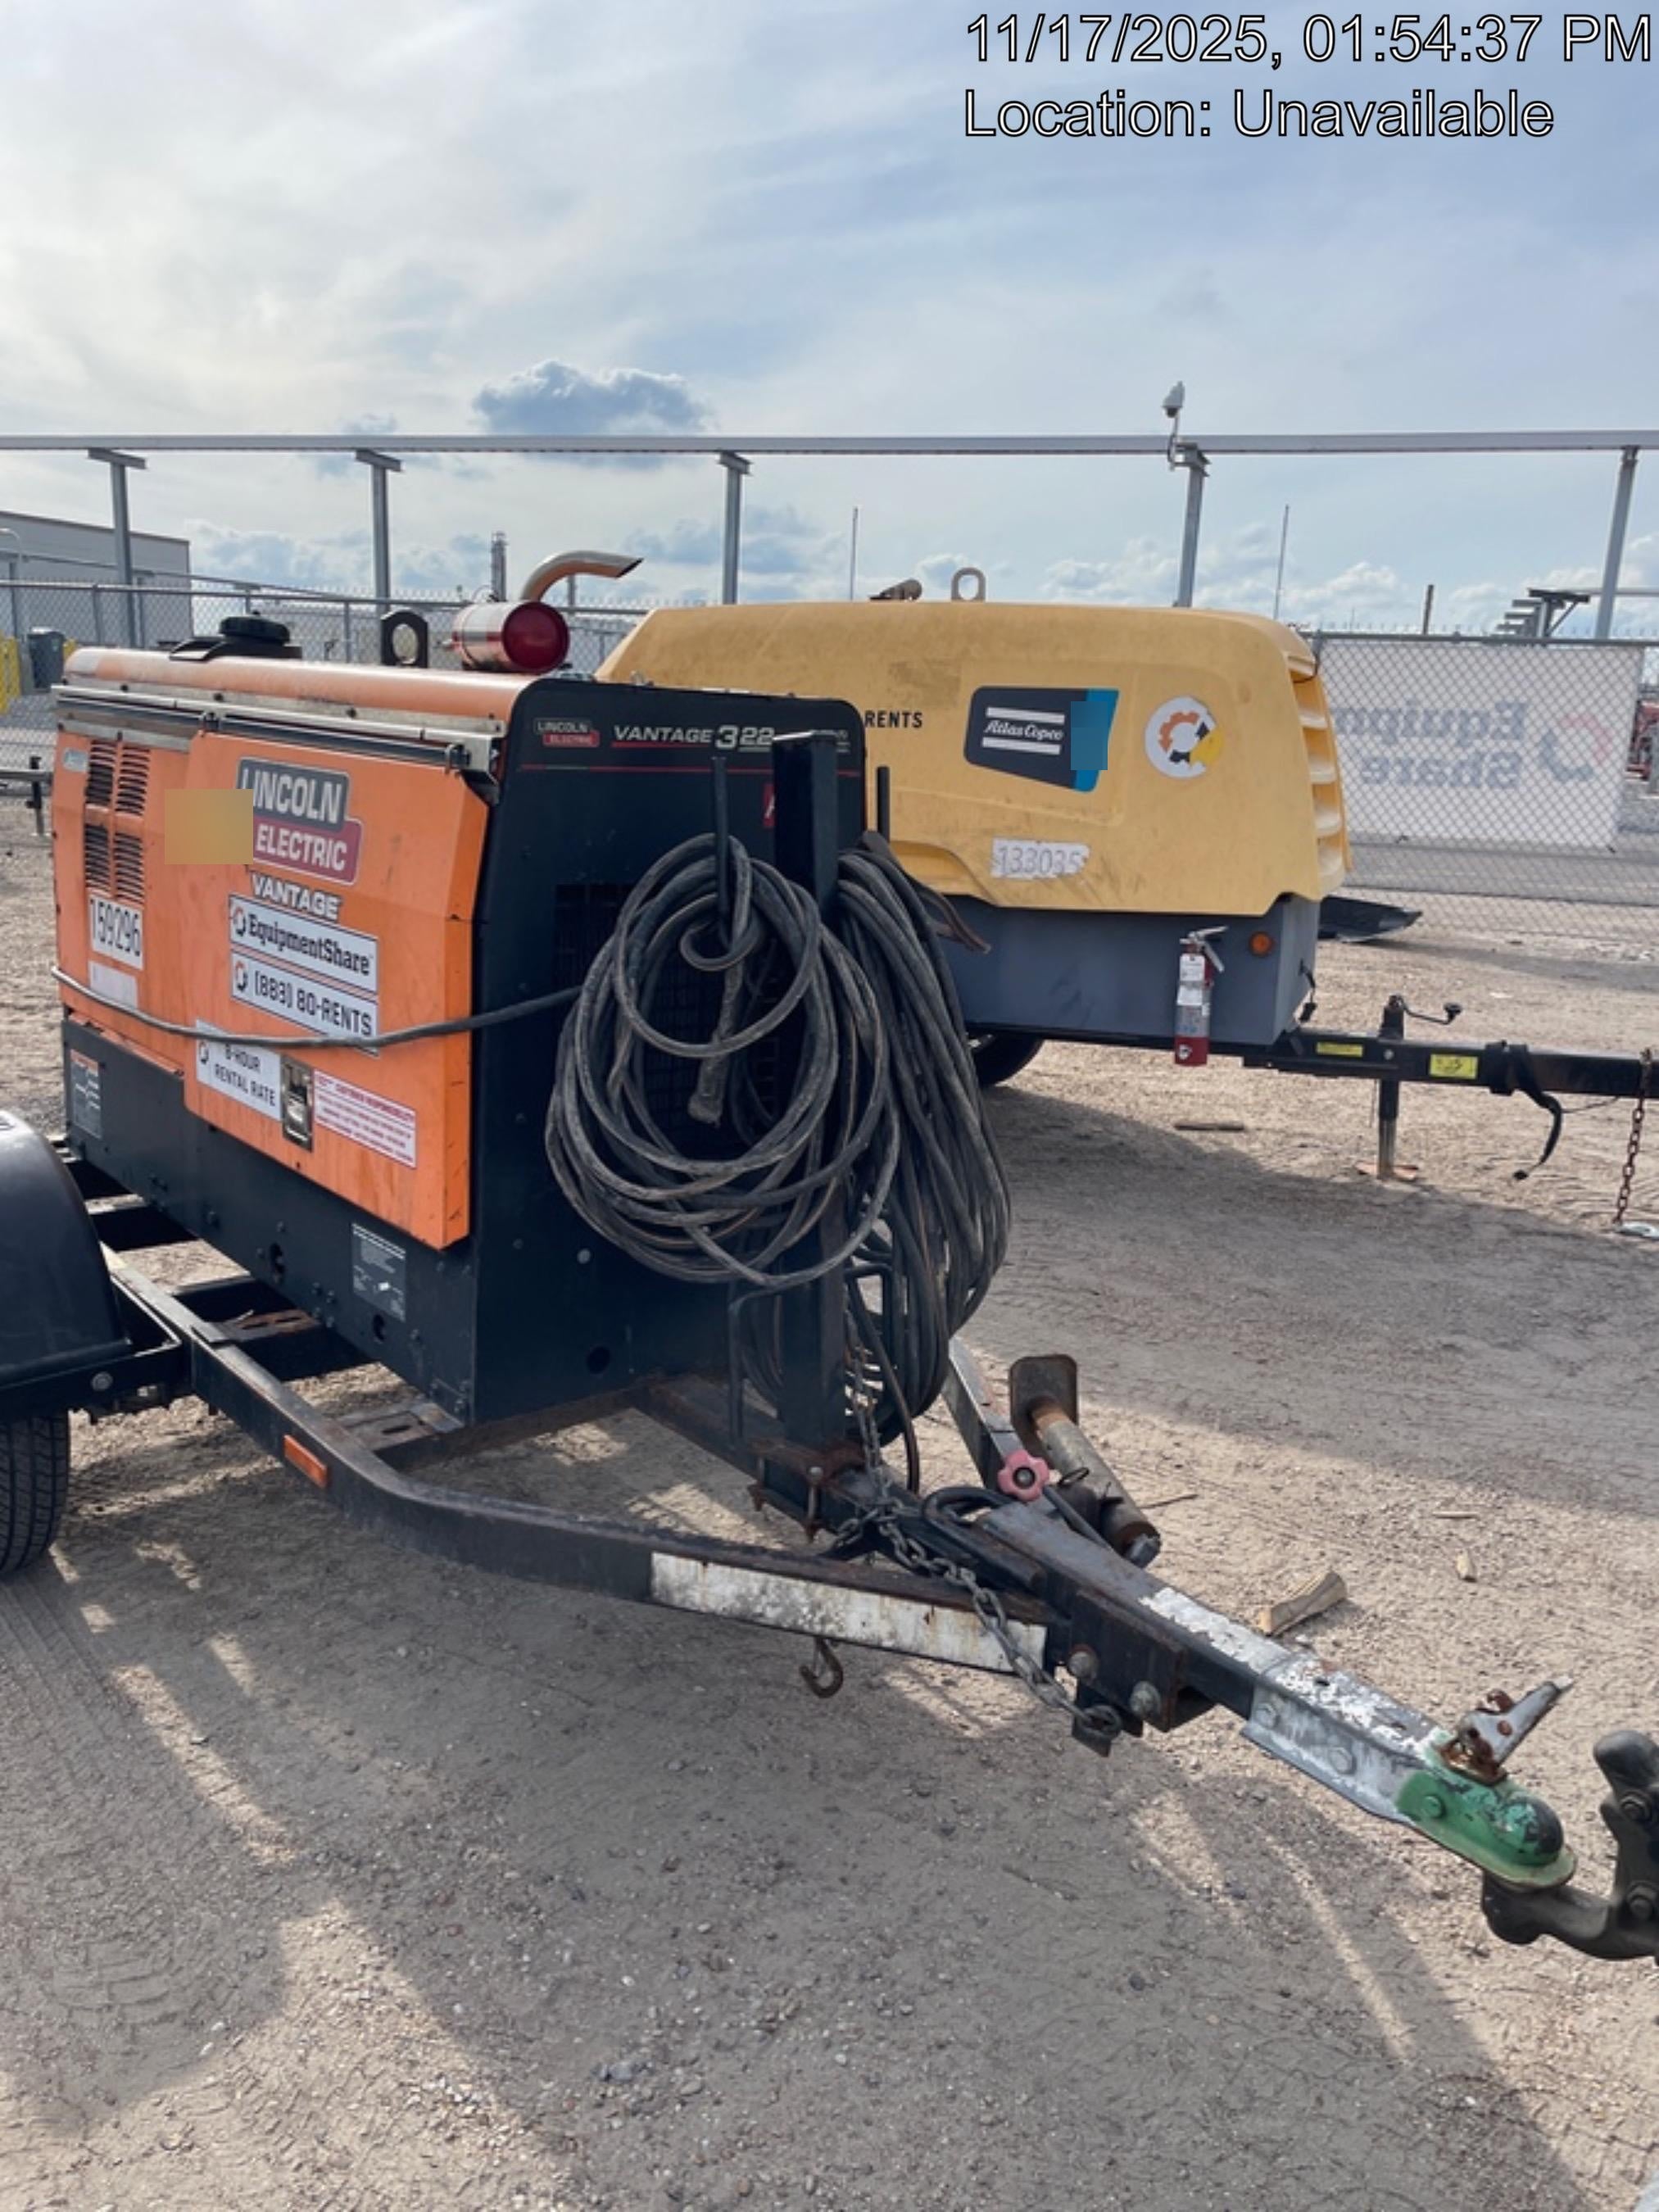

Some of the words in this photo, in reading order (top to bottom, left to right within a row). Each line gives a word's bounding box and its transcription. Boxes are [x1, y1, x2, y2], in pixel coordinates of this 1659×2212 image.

[537, 721, 587, 733] LINCOLN
[614, 725, 713, 743] VANTAGE
[714, 725, 774, 749] 322
[984, 720, 1023, 737] Atlas
[1024, 723, 1063, 741] Copco
[256, 823, 347, 872] ELECTRIC
[252, 873, 342, 921] VANTAGE
[90, 899, 141, 957] 159296
[248, 914, 369, 975] EquipmentShare
[297, 987, 372, 1036] 80-RENTS
[215, 1063, 248, 1094] RENTAL
[251, 1080, 276, 1107] RATE
